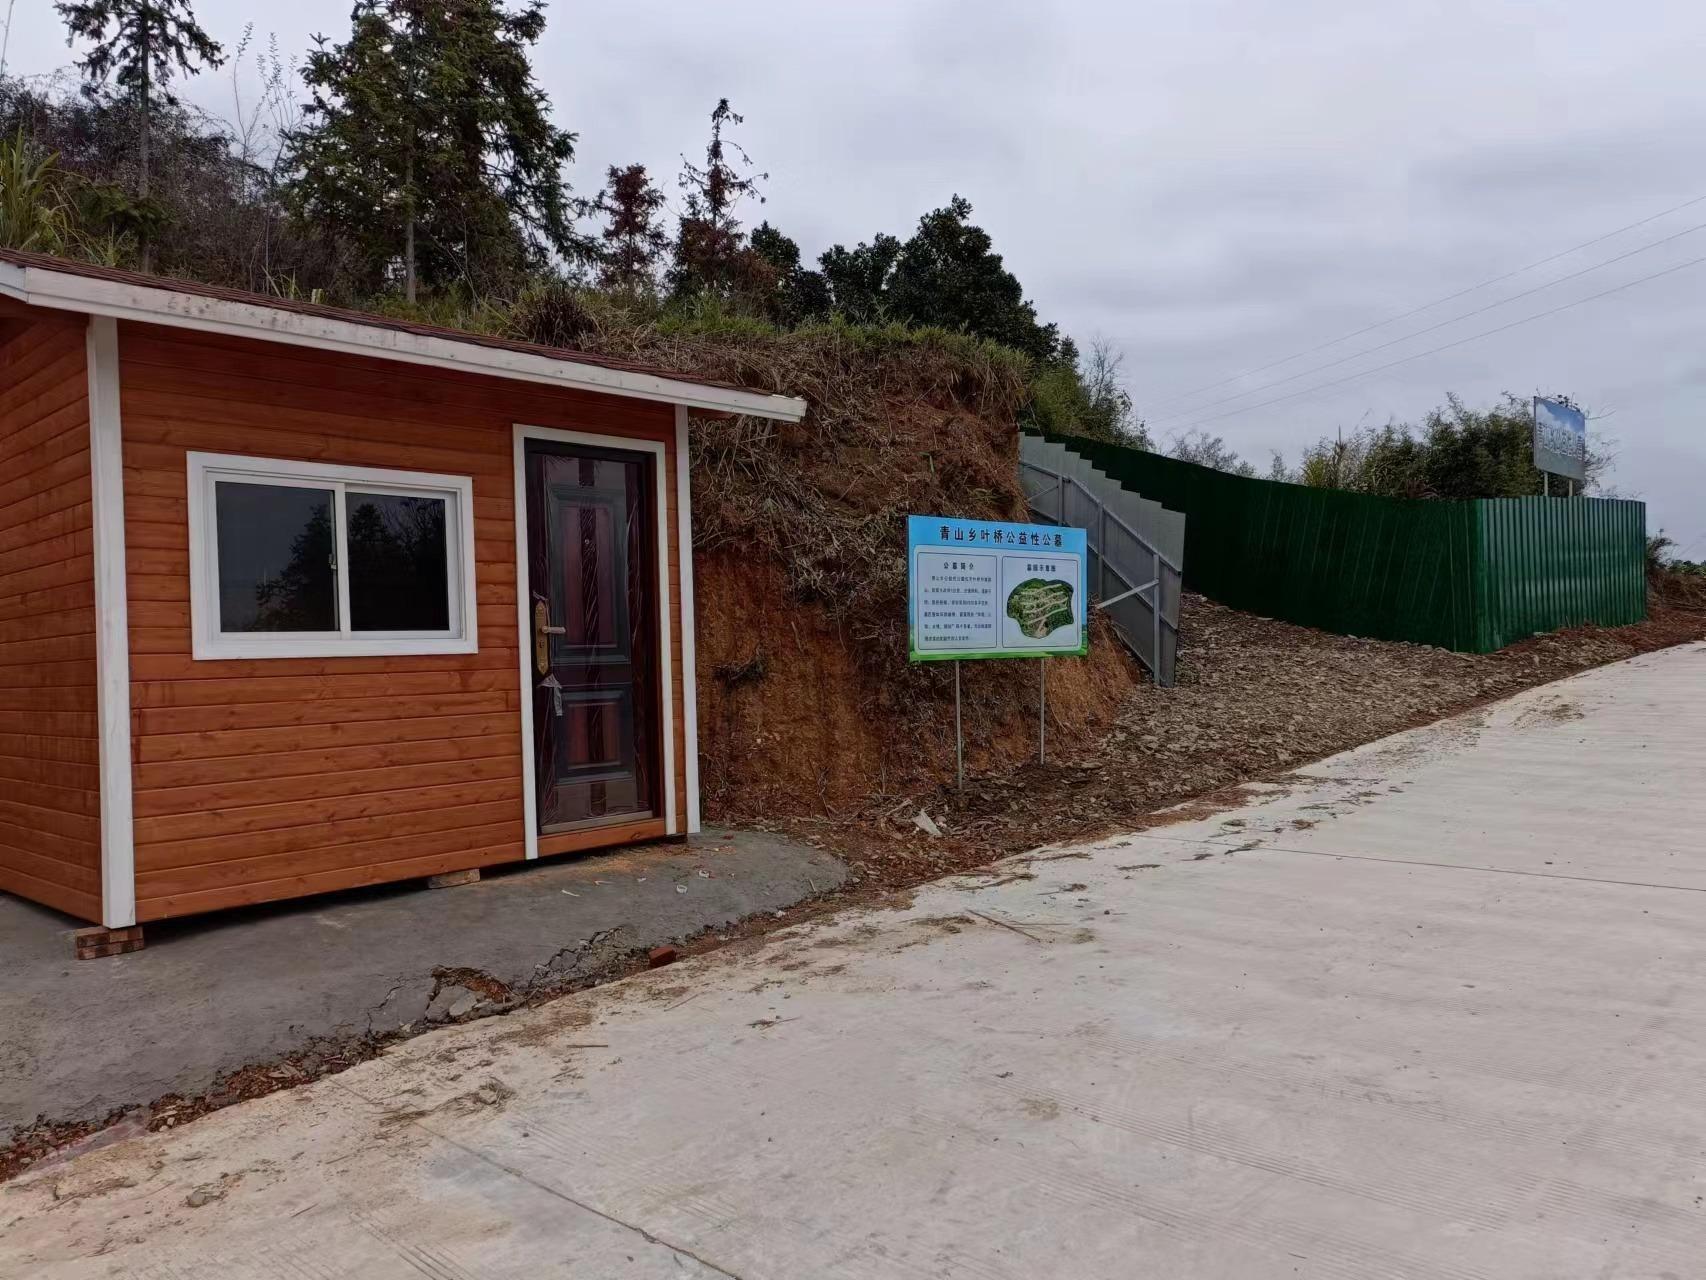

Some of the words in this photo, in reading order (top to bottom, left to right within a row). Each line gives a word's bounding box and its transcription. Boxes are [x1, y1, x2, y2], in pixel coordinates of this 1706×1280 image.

[939, 526, 1064, 547] 青山乡叶桥公益性公墓
